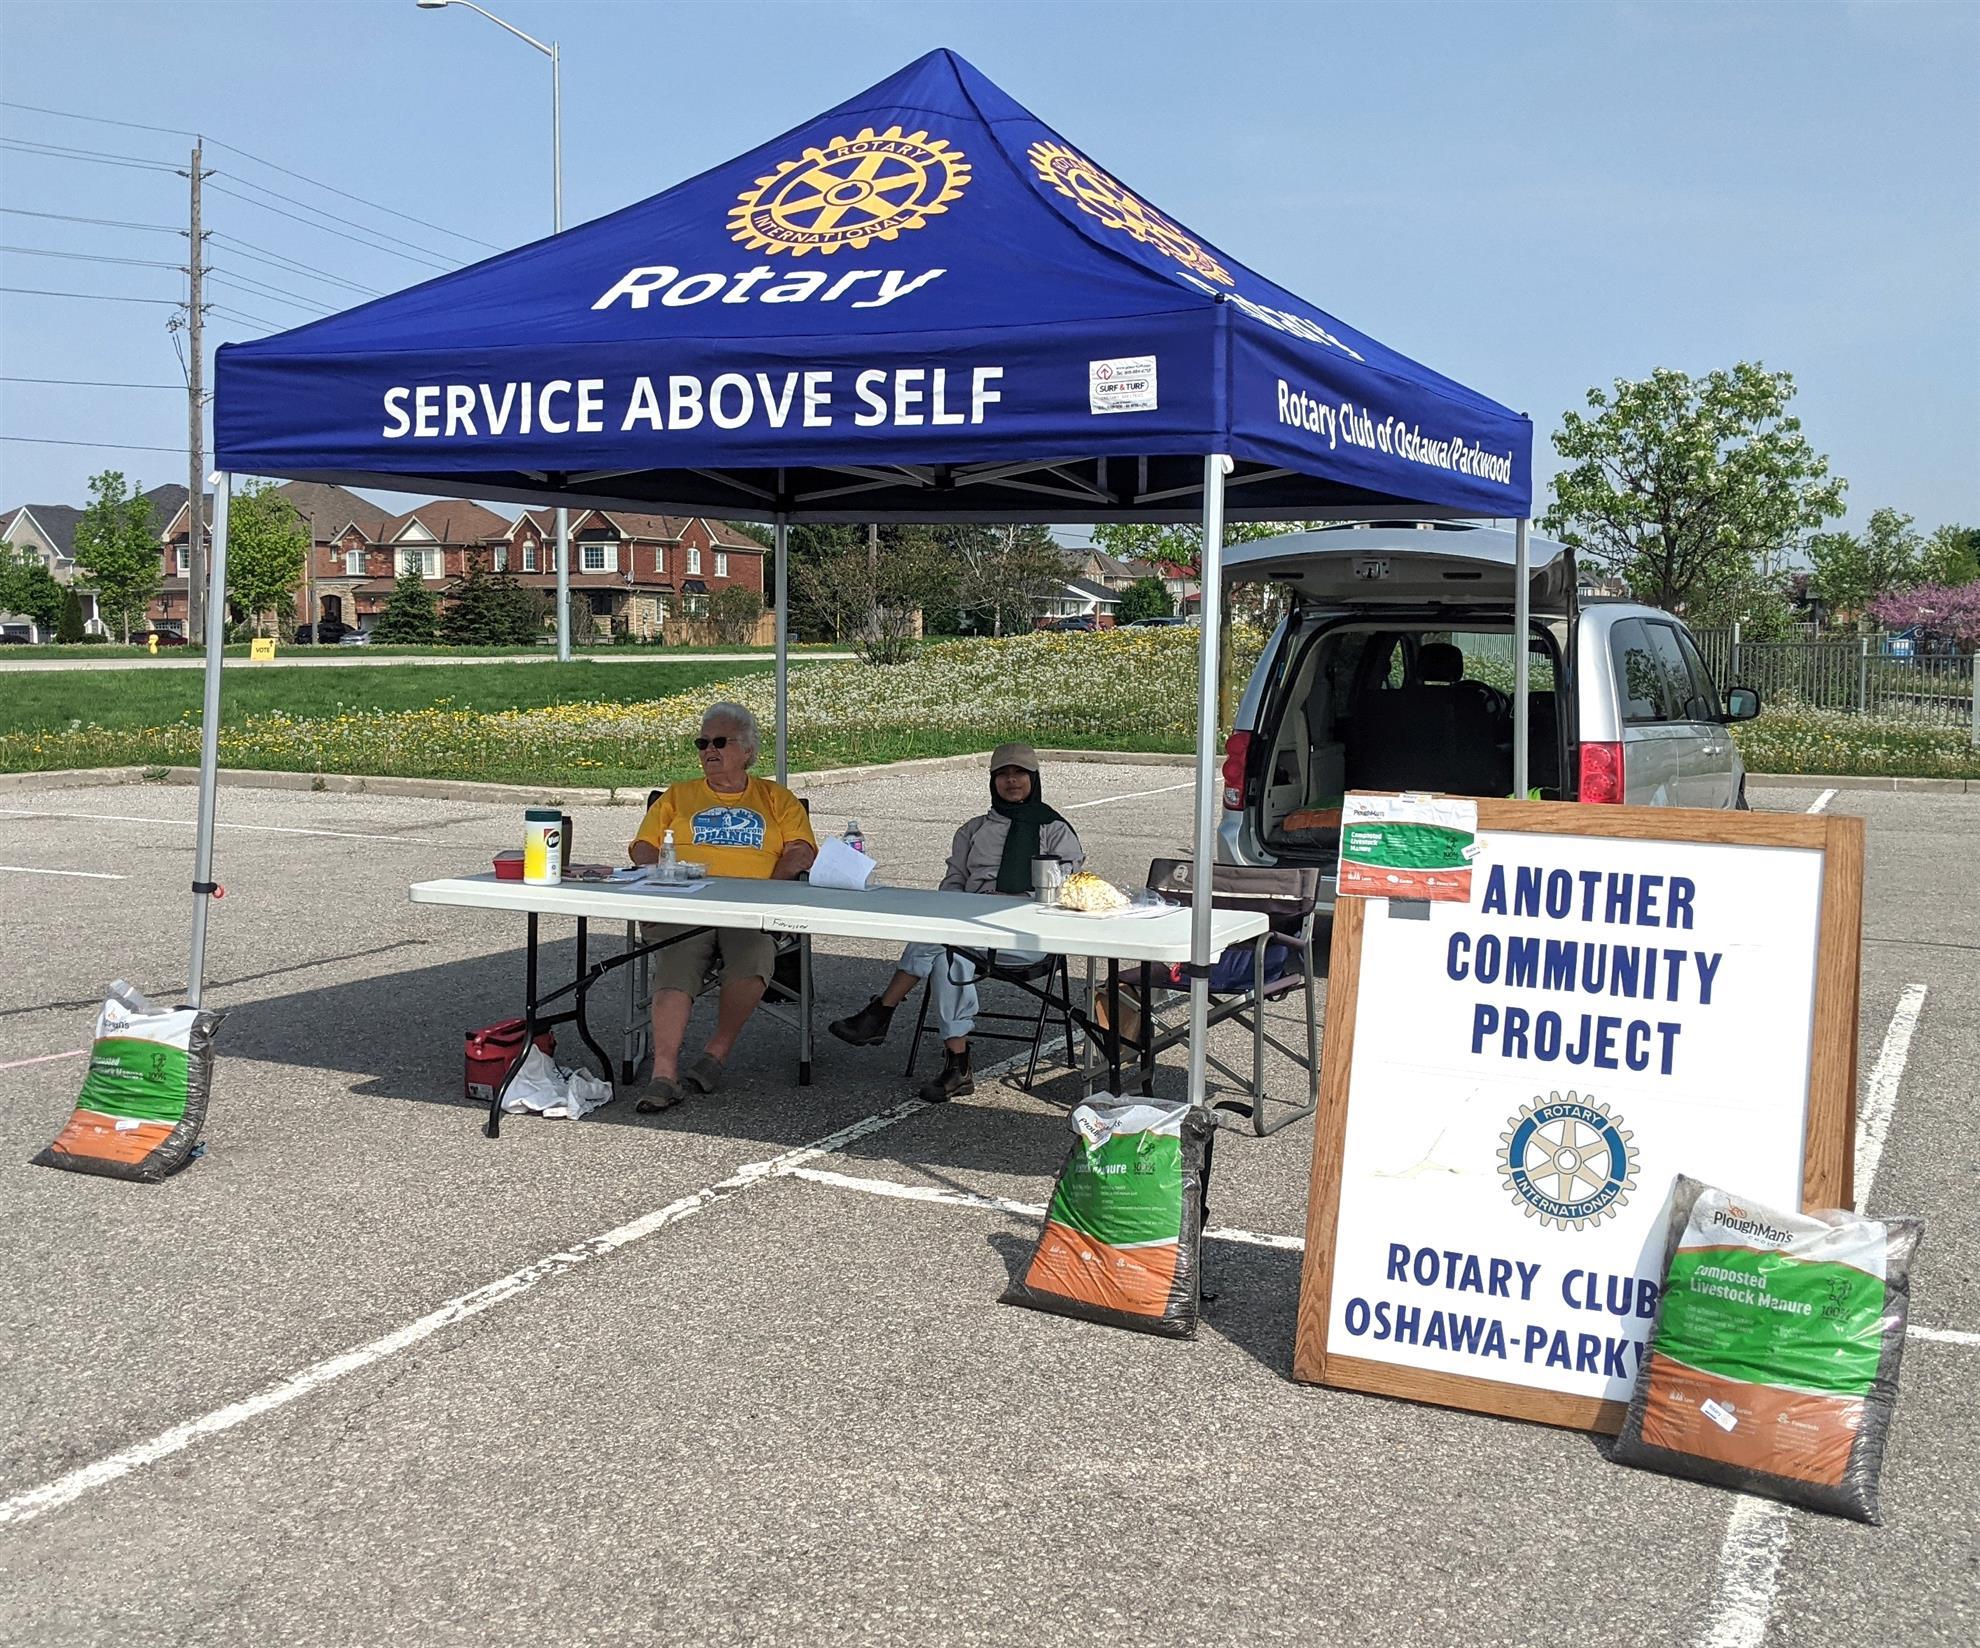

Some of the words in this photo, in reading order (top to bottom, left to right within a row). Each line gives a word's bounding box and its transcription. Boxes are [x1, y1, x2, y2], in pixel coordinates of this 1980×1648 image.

[837, 141, 928, 158] ROTARY
[754, 213, 910, 243] INTERNATIONAL
[591, 265, 947, 310] Rotary
[382, 379, 604, 439] SERVICE
[620, 370, 834, 432] ABOVE
[854, 366, 1004, 428] SELF
[1099, 384, 1118, 392] SURF
[1126, 382, 1145, 390] TURF
[1277, 379, 1336, 450] Rotary
[1339, 403, 1376, 450] Club
[1377, 416, 1395, 455] of
[1395, 421, 1513, 485] Oshawa/Parkwood
[694, 830, 763, 848] CHANGE
[1481, 864, 1696, 930] ANOTHER
[1447, 931, 1723, 1005] COMMUNITY
[1471, 1003, 1682, 1076] PROJECT
[1543, 1105, 1602, 1123] ROTARY
[1516, 1177, 1617, 1217] INTERNATIONAL
[1713, 1211, 1794, 1243] PloughMan's
[1387, 1243, 1542, 1301] ROTARY
[1562, 1269, 1659, 1319] CLUB
[1690, 1278, 1755, 1305] Livestock
[1757, 1293, 1813, 1316] Manure
